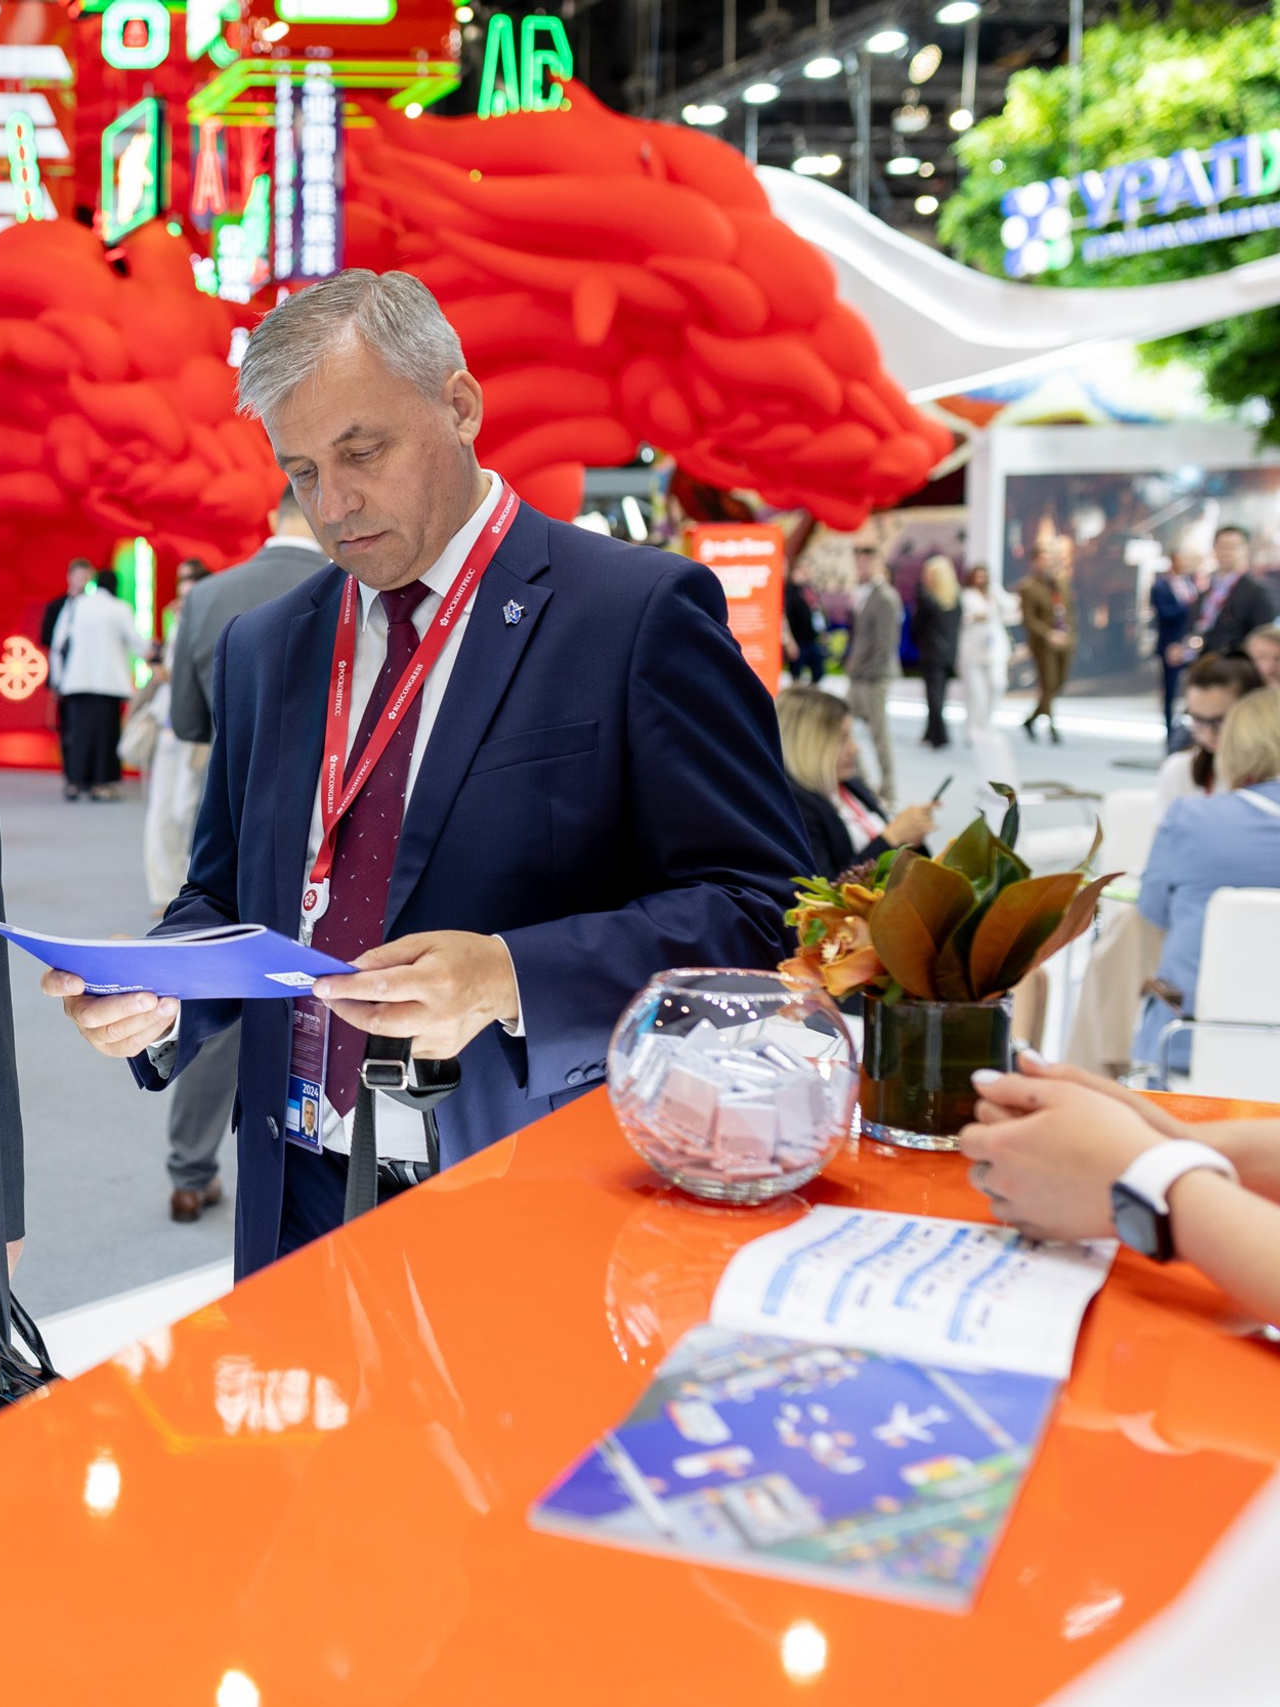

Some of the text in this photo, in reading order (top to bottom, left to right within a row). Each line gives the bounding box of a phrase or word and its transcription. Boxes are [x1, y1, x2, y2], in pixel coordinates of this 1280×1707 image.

[444, 568, 476, 619] РОСКОНГРЕСС
[334, 668, 345, 717] РОСКОНГРЕСС
[392, 663, 423, 712] ROSCONGRESS
[327, 762, 336, 814] ROSCONGRESS
[341, 757, 371, 807] РОСКОНГРЕСС
[302, 1083, 319, 1098] 2024
